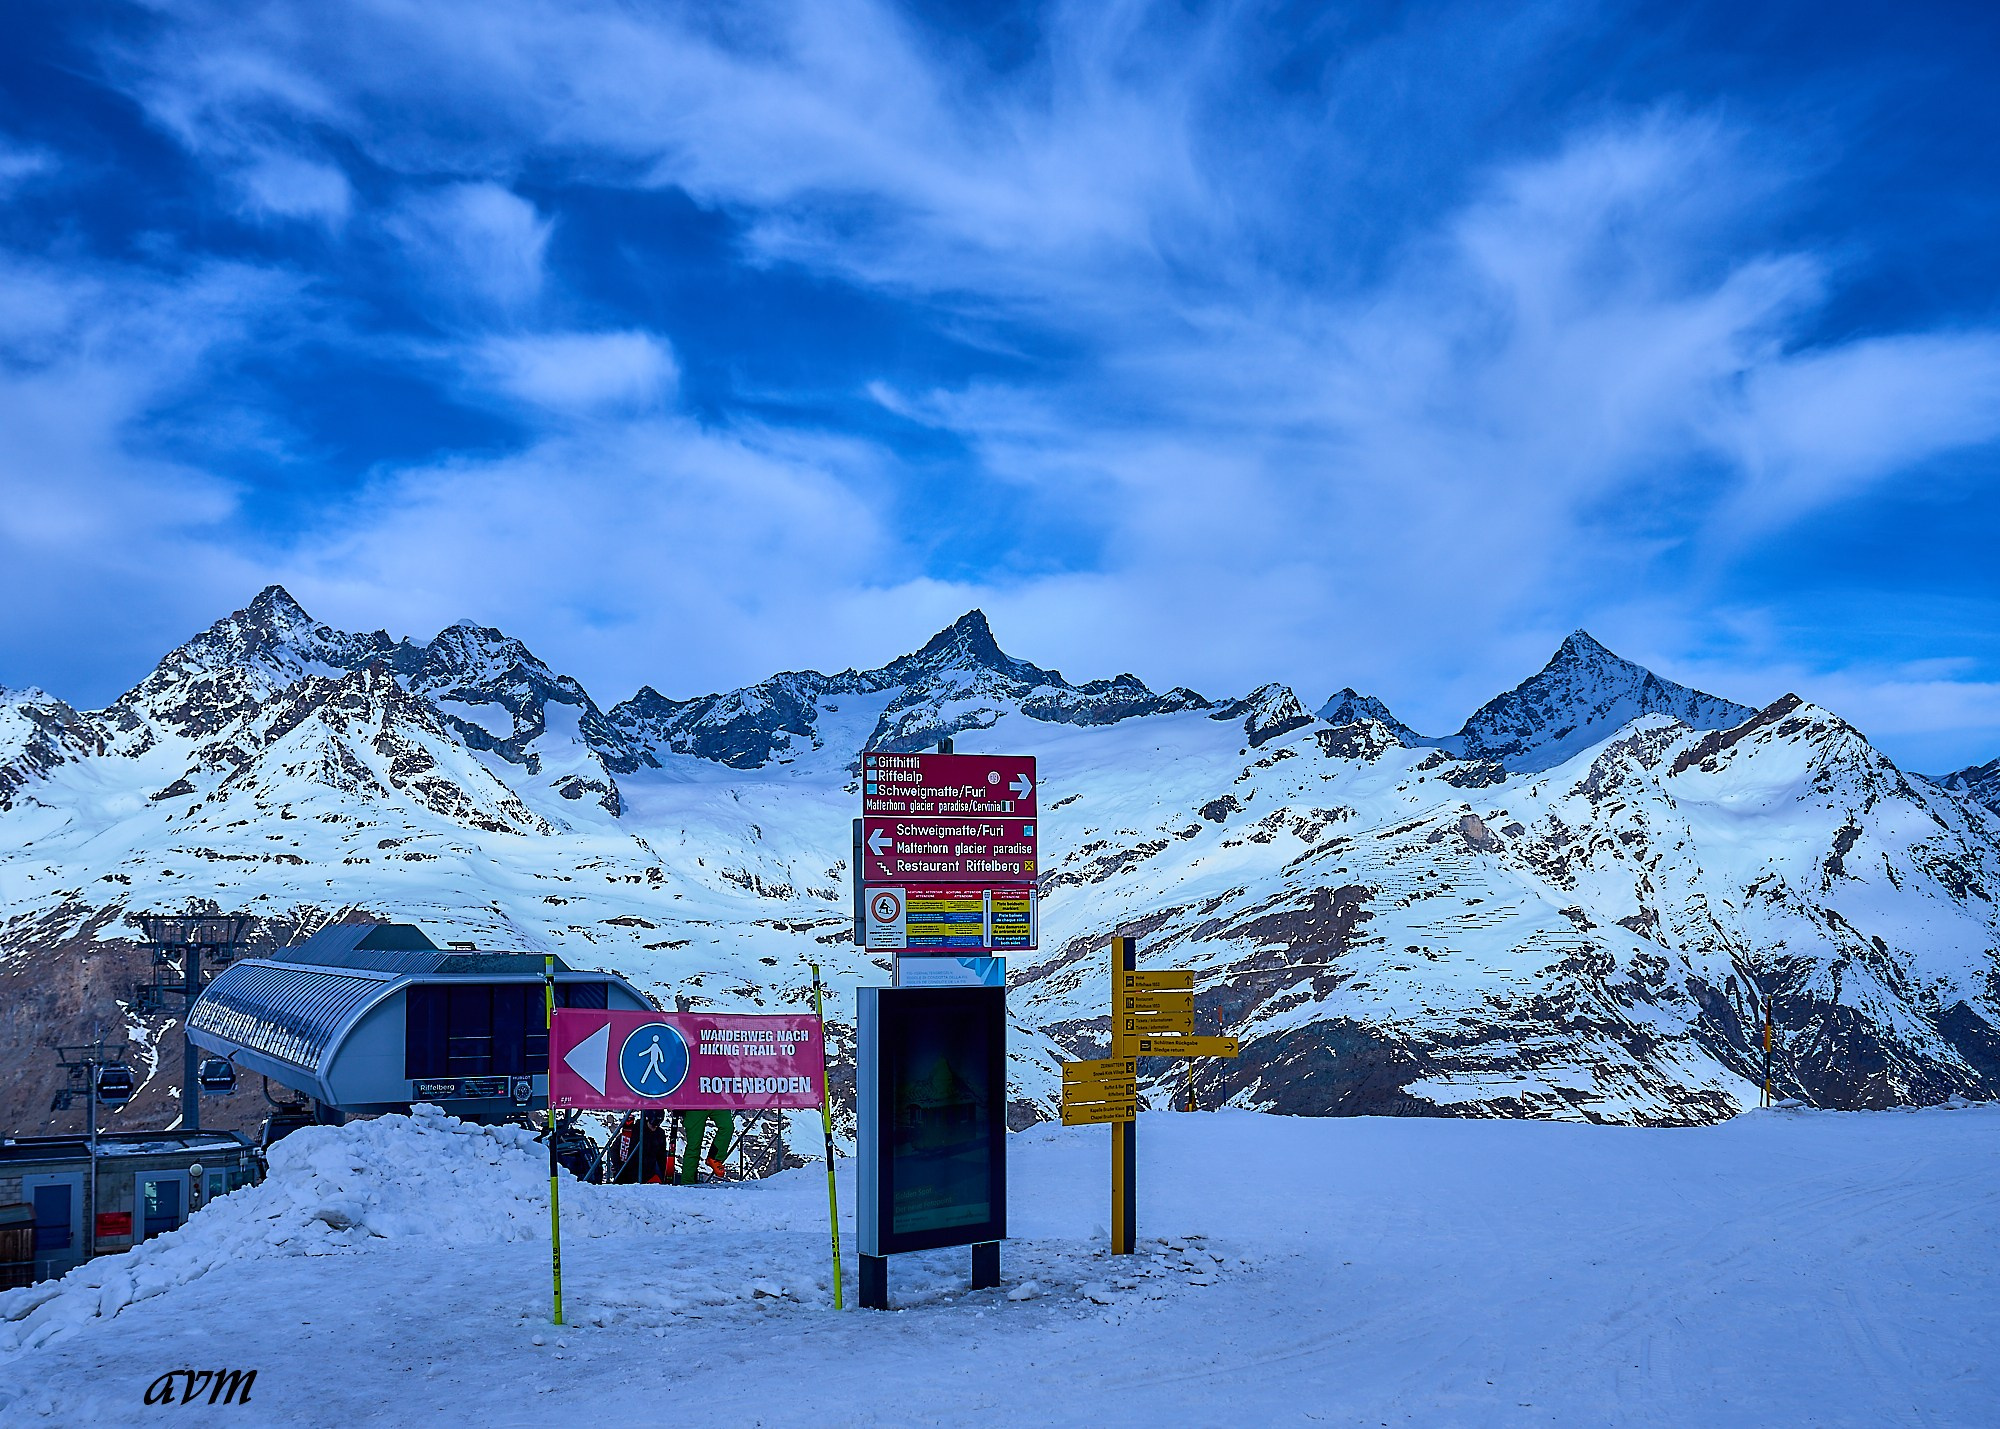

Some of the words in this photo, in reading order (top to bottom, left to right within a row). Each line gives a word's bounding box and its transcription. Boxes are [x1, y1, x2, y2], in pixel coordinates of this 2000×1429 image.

[878, 757, 920, 768] Gifthittli
[879, 771, 922, 783] Riffelalp
[879, 785, 986, 798] Schweigmatte/Furi
[867, 800, 905, 811] Matterhorn
[910, 800, 934, 812] glacier
[939, 800, 1000, 813] paradise/Cervinia
[897, 824, 1004, 838] Schweigmatte/Furi
[897, 842, 948, 854] Matterhorn
[955, 843, 986, 856] glacier
[994, 843, 1032, 855] paradise
[897, 860, 960, 872] Restaurant
[966, 860, 1020, 874] Riffelberg
[700, 1029, 773, 1042] WANDERWEG
[777, 1030, 808, 1042] NACH
[700, 1044, 738, 1055] HIKING
[742, 1044, 776, 1056] TRAIL
[780, 1044, 795, 1056] TO
[700, 1077, 811, 1094] ROTENBODEN
